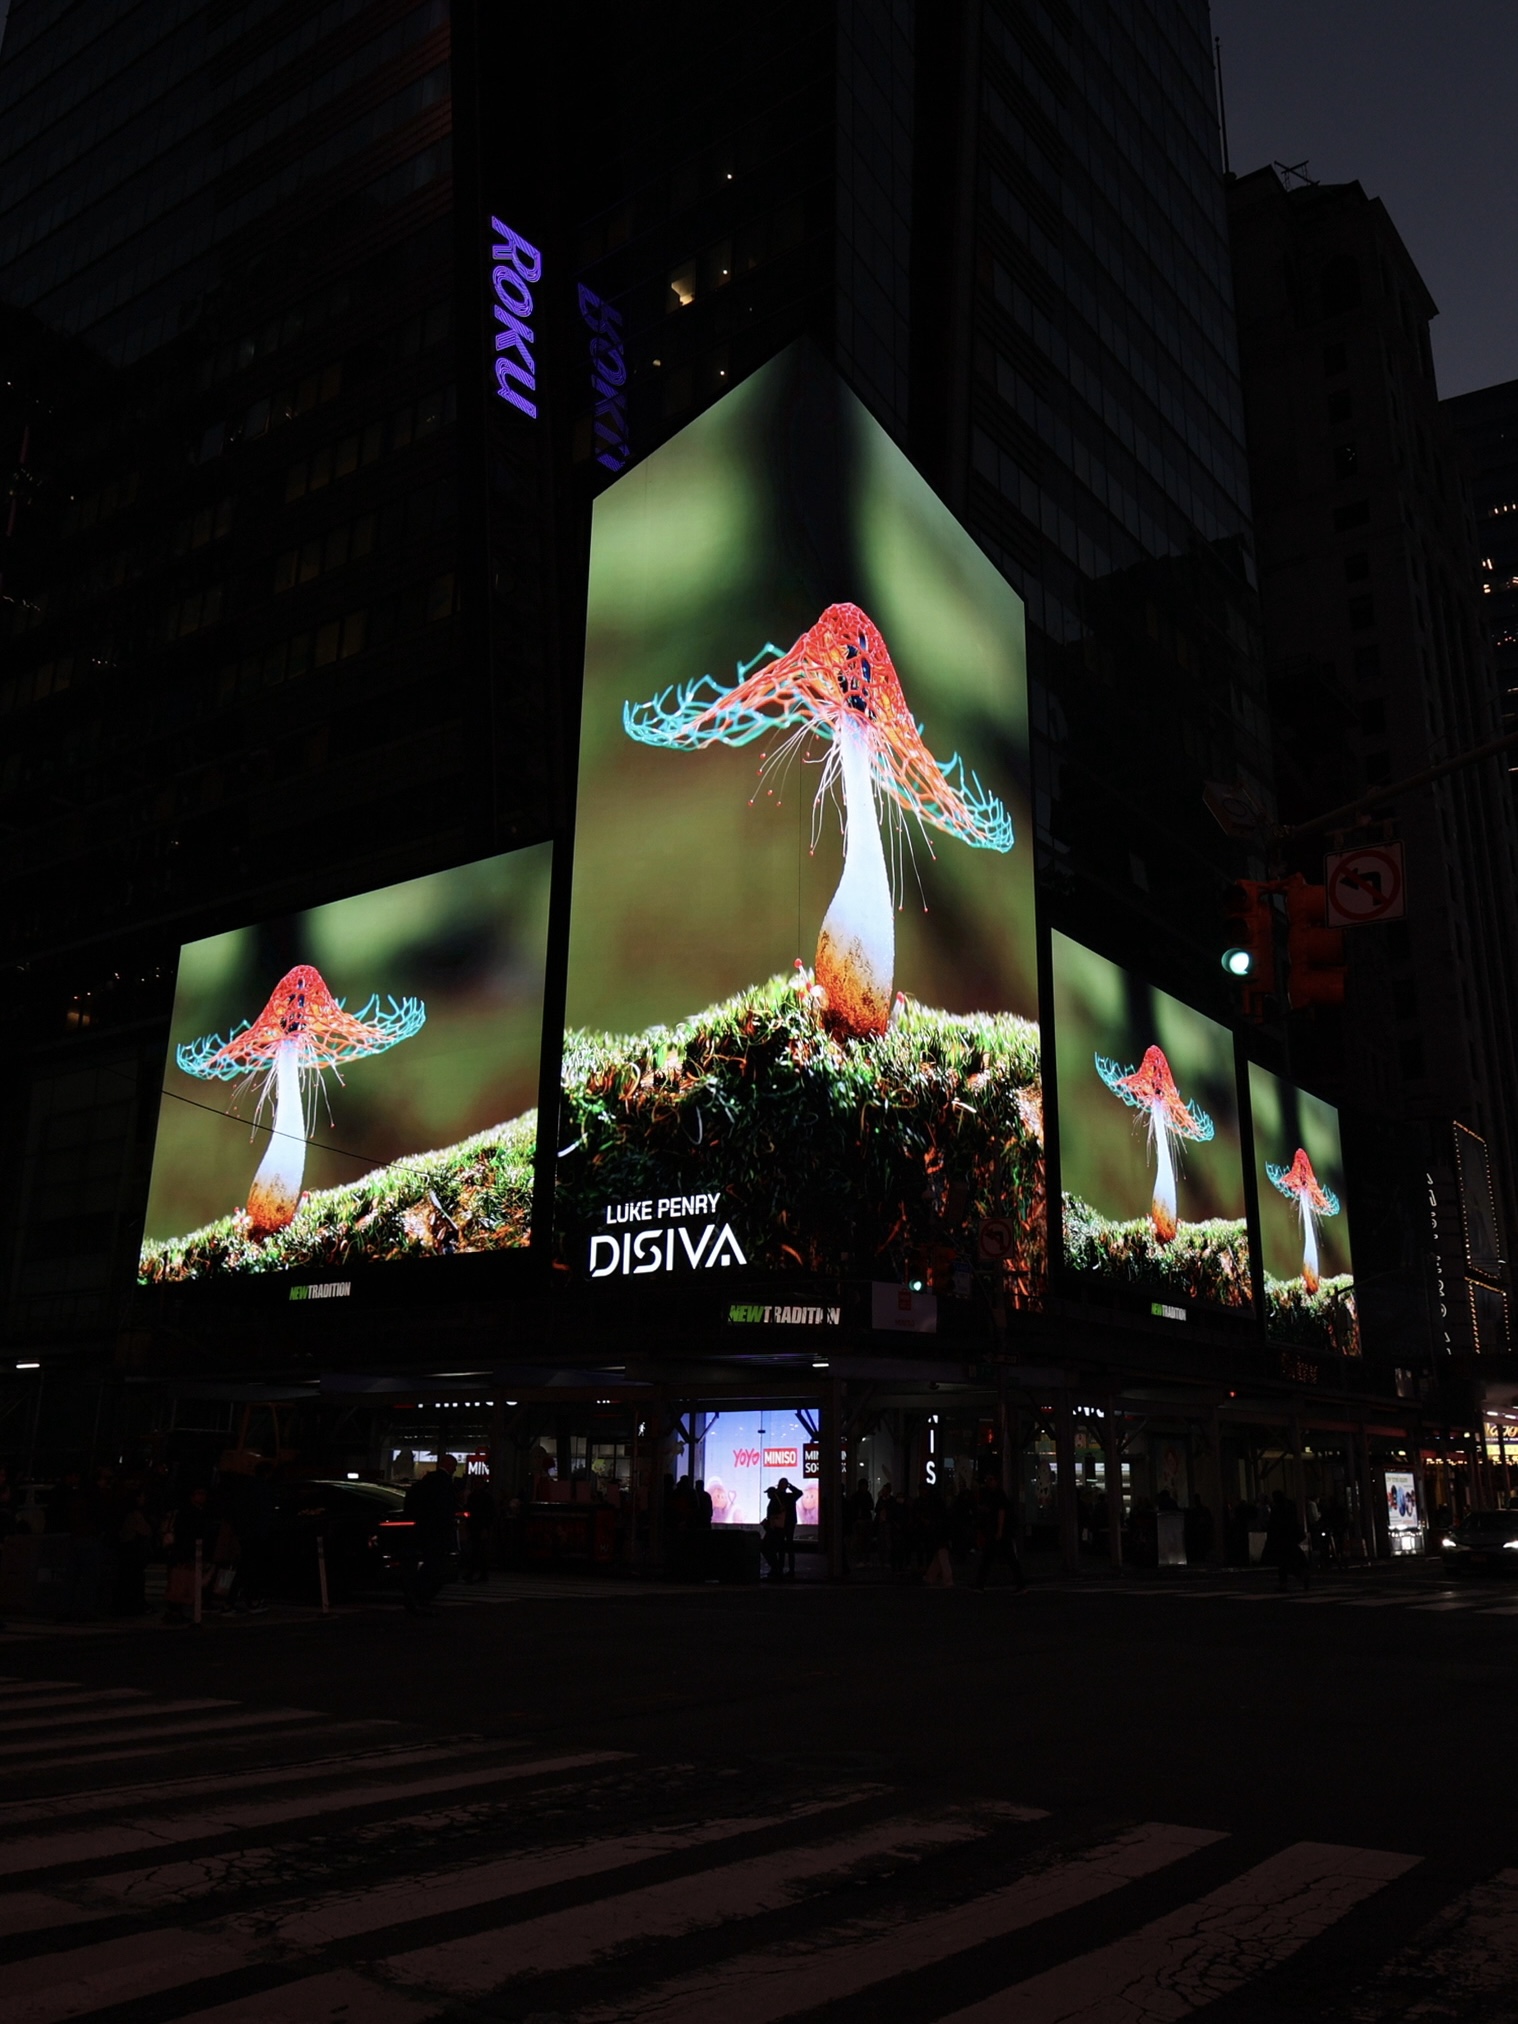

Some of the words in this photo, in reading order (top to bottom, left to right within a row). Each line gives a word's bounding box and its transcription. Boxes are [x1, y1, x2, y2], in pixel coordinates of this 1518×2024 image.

[490, 214, 544, 420] ROKU
[605, 1200, 653, 1225] LUKE
[657, 1192, 721, 1219] PENRY
[588, 1222, 748, 1278] DISIVA
[764, 1451, 796, 1465] MINISO
